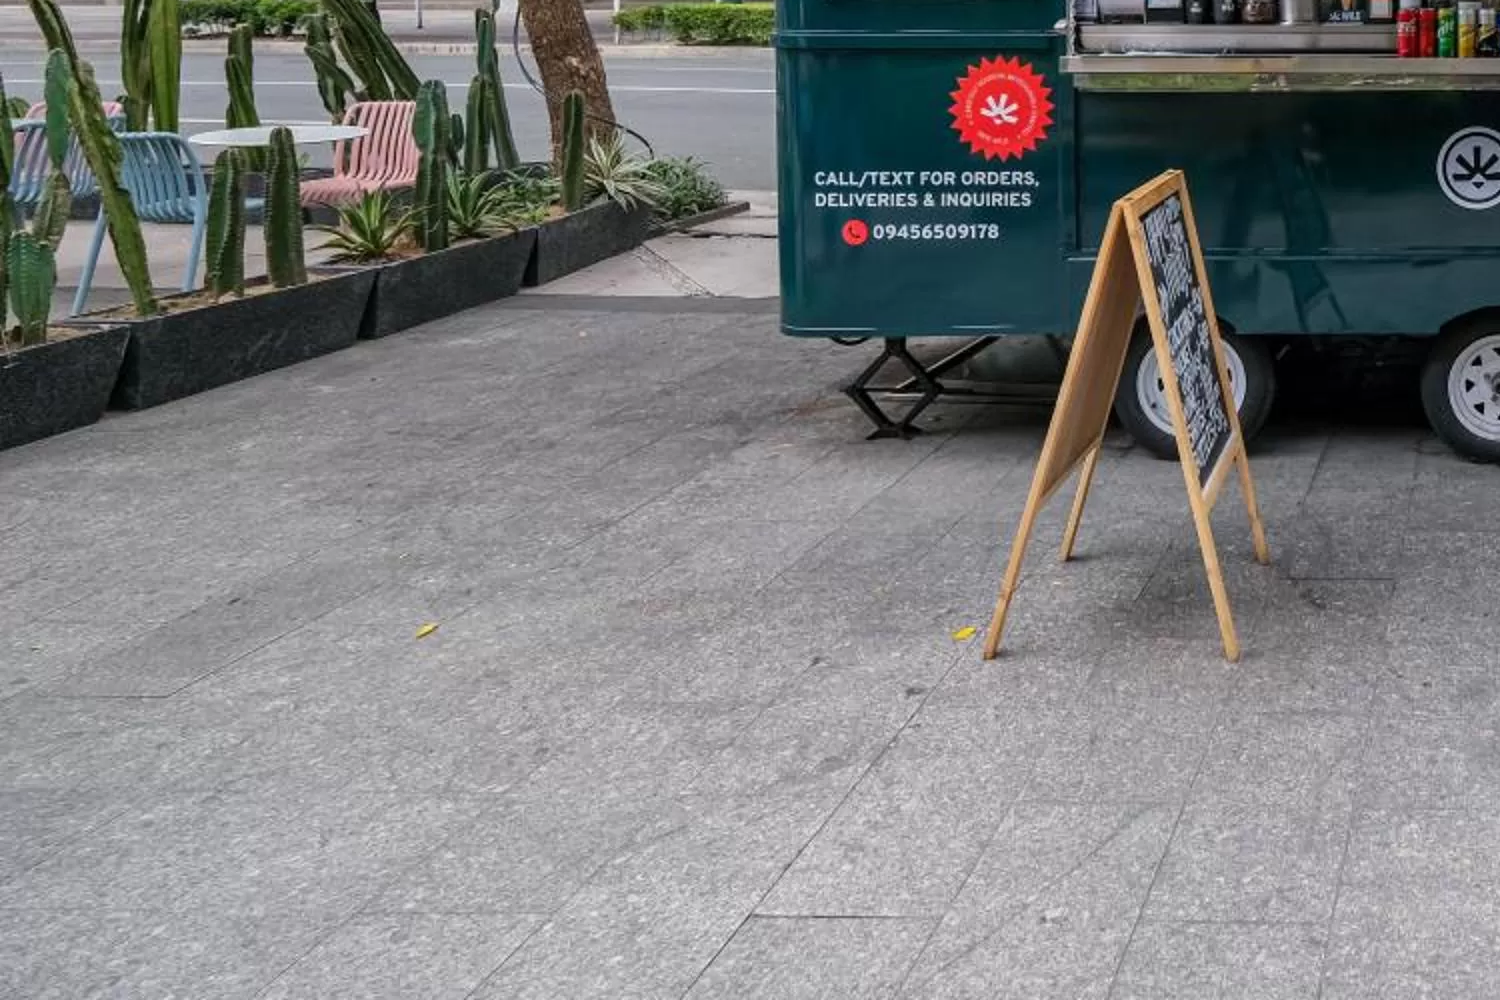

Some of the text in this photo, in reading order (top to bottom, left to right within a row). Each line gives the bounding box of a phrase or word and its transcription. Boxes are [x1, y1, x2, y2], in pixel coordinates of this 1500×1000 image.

[814, 171, 1040, 188] CALL/TEXT FOR ORDERS,
[815, 193, 1032, 207] DELIVERIES & INQUIRIES
[873, 224, 999, 240] 09456509178
